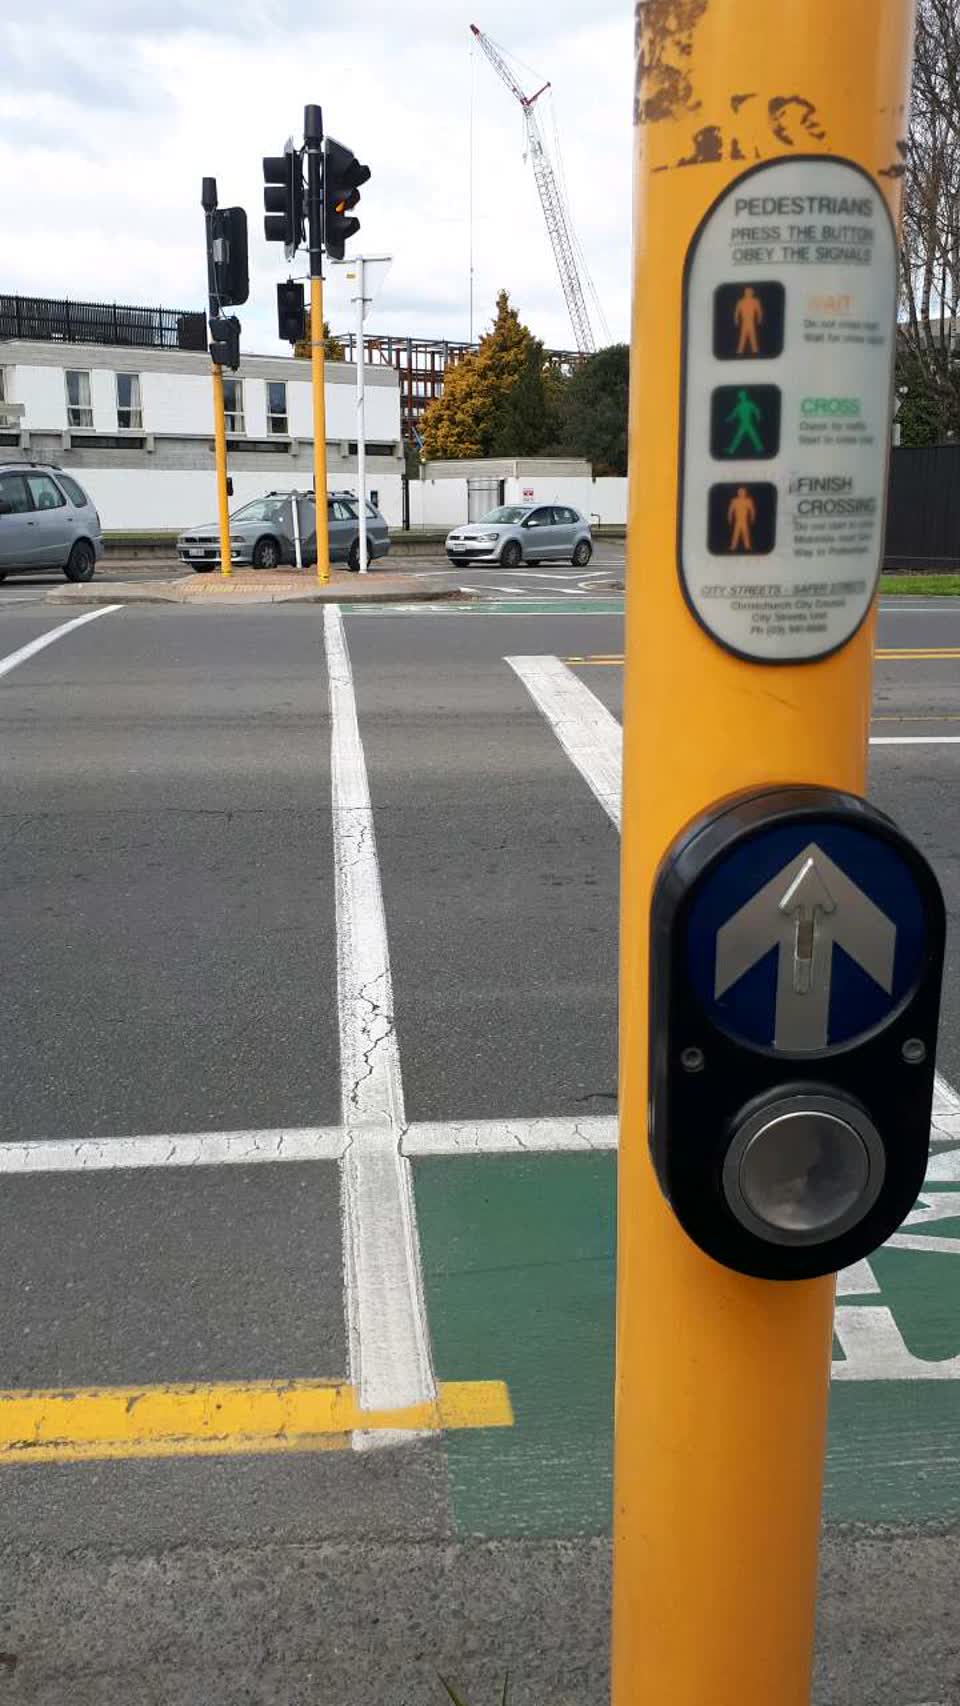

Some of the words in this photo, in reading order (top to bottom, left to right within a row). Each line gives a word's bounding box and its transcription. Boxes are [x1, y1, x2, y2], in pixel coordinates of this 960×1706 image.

[735, 196, 873, 217] PEDESTRIANS
[730, 227, 781, 241] PRESS
[787, 225, 816, 240] THE
[822, 225, 875, 241] BUTTON
[731, 247, 775, 262] OBEY
[782, 246, 809, 261] THE
[816, 246, 872, 263] SIGNALS
[801, 397, 859, 416] CROSS
[798, 476, 853, 492] FINISH
[798, 498, 877, 514] CROSSING
[702, 585, 726, 595] CITY
[729, 584, 782, 596] STREETS
